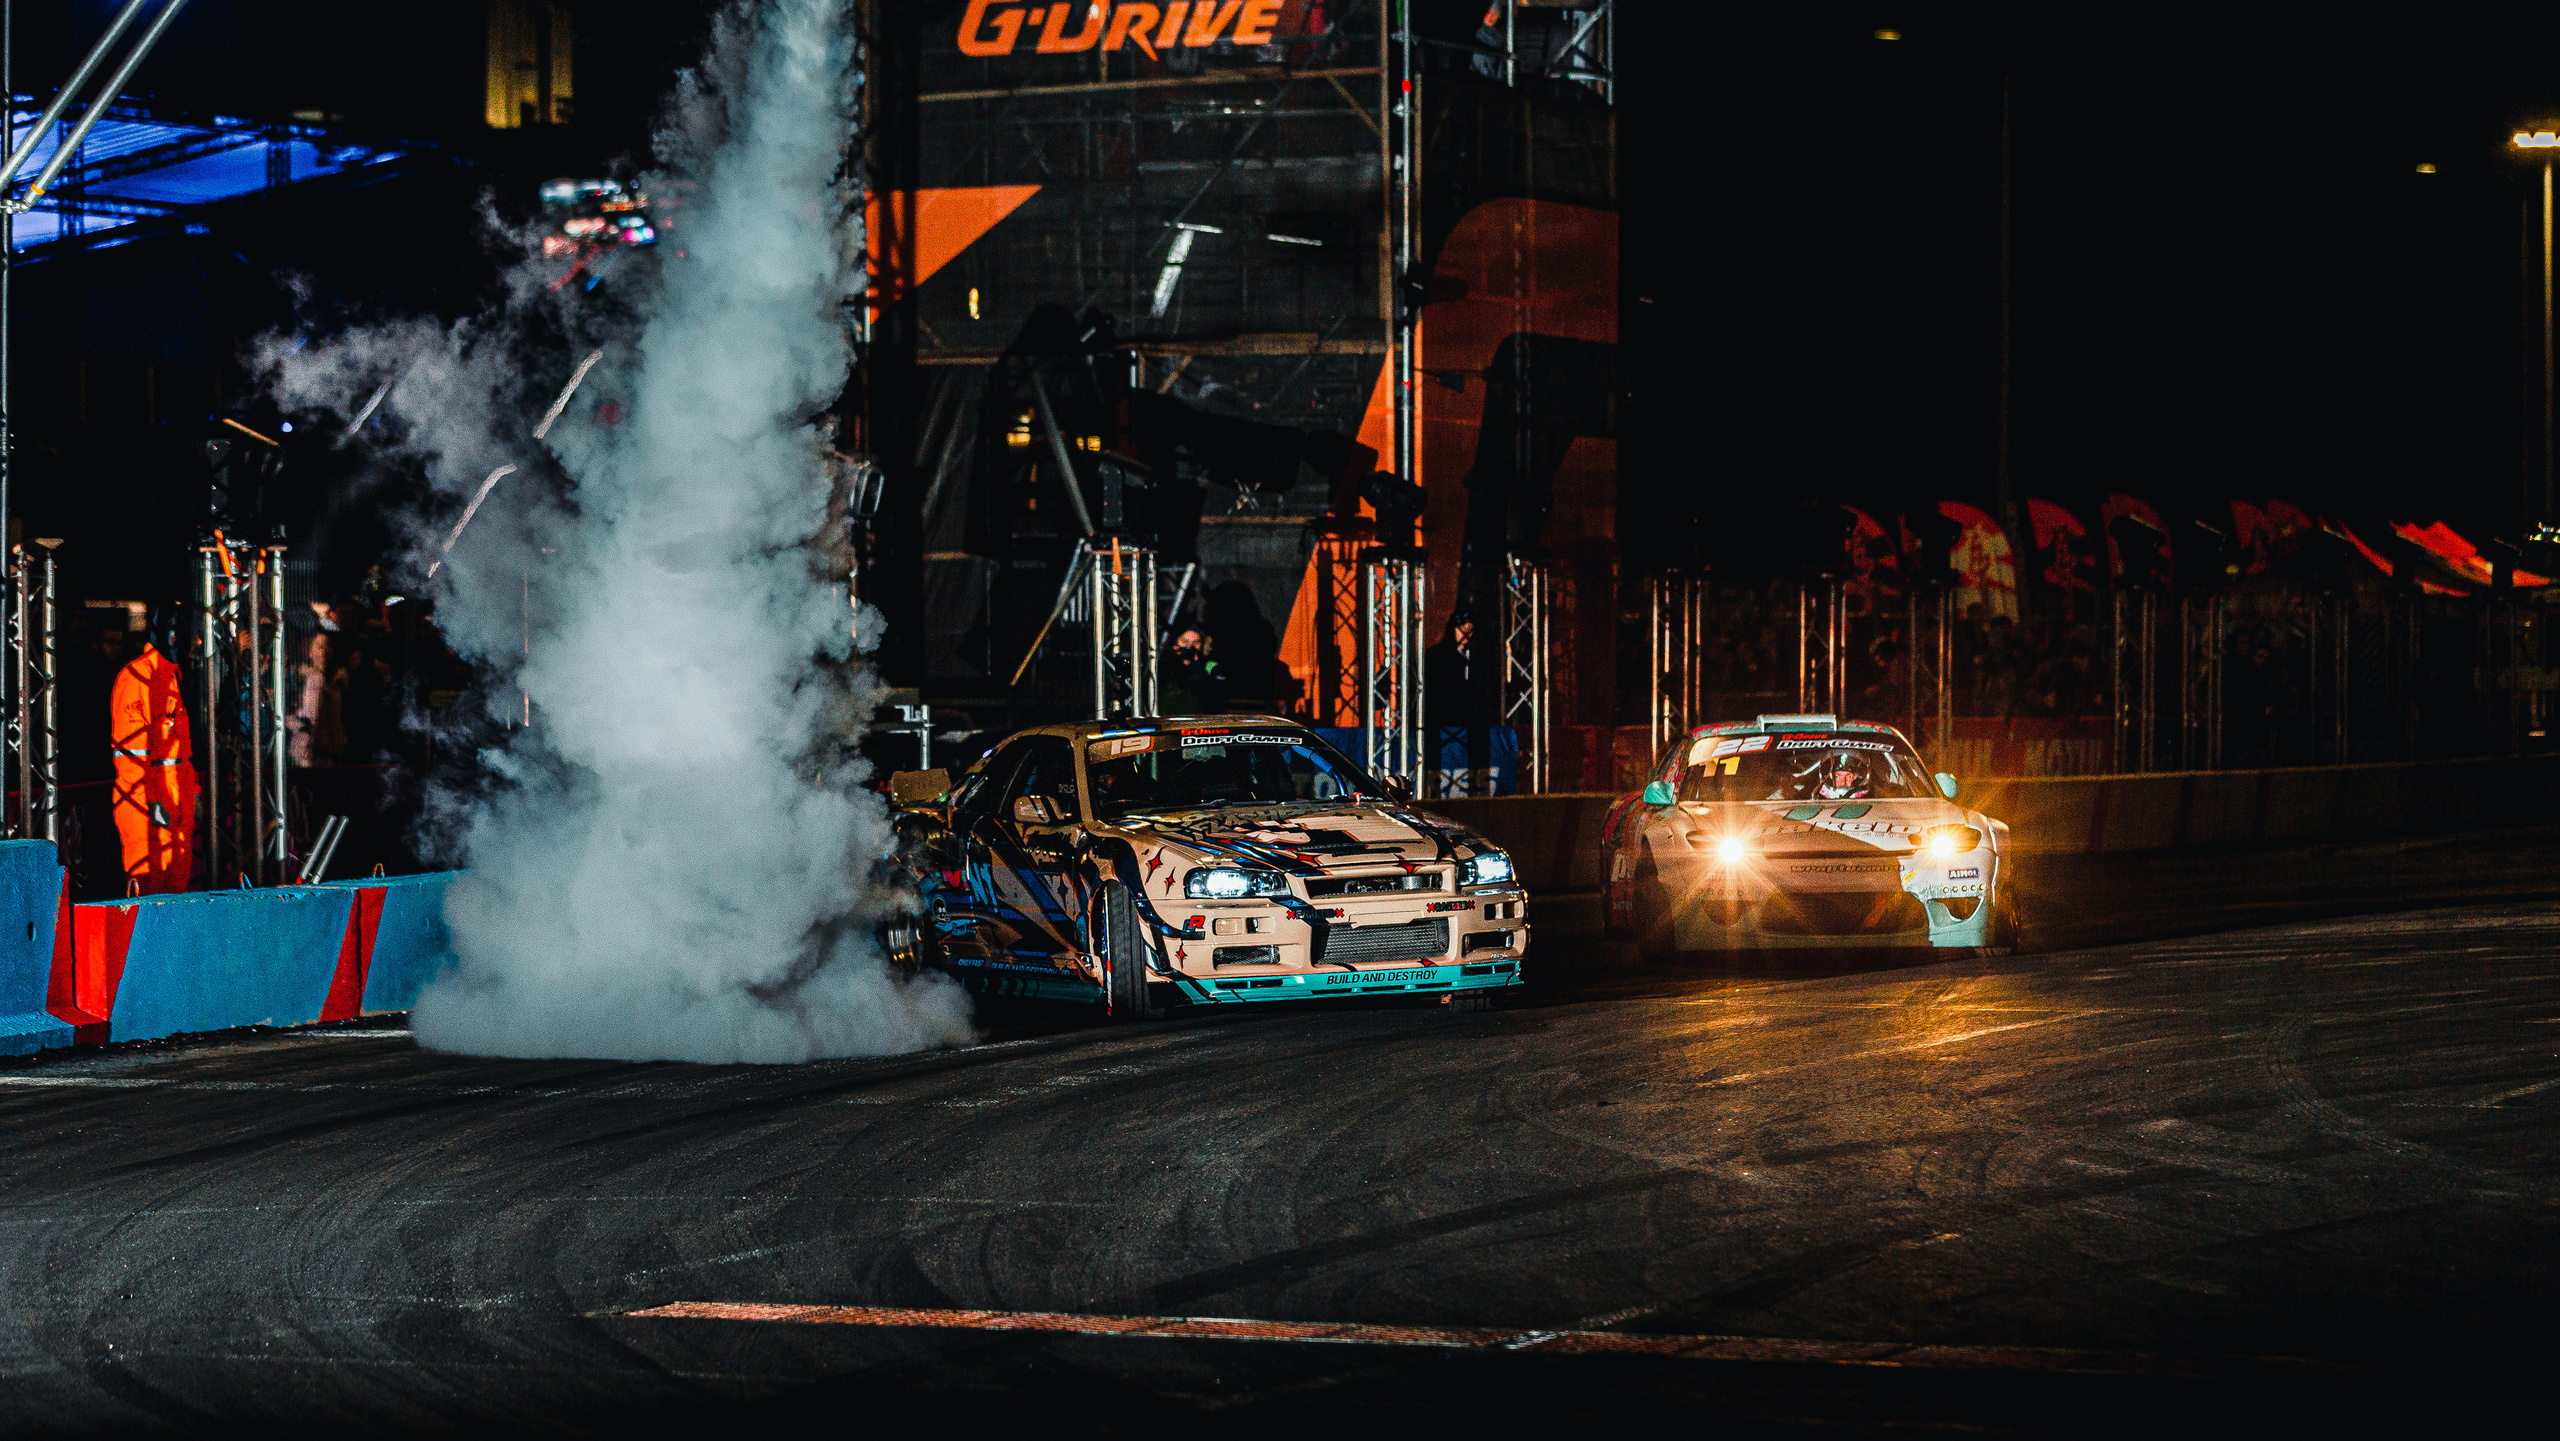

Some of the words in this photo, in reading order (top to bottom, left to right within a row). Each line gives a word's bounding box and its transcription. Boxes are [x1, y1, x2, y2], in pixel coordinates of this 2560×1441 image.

[1110, 734, 1151, 756] 19
[1711, 735, 1772, 757] 22
[1326, 974, 1360, 985] BUILD
[1361, 972, 1386, 983] AND
[1387, 969, 1438, 982] DESTROY
